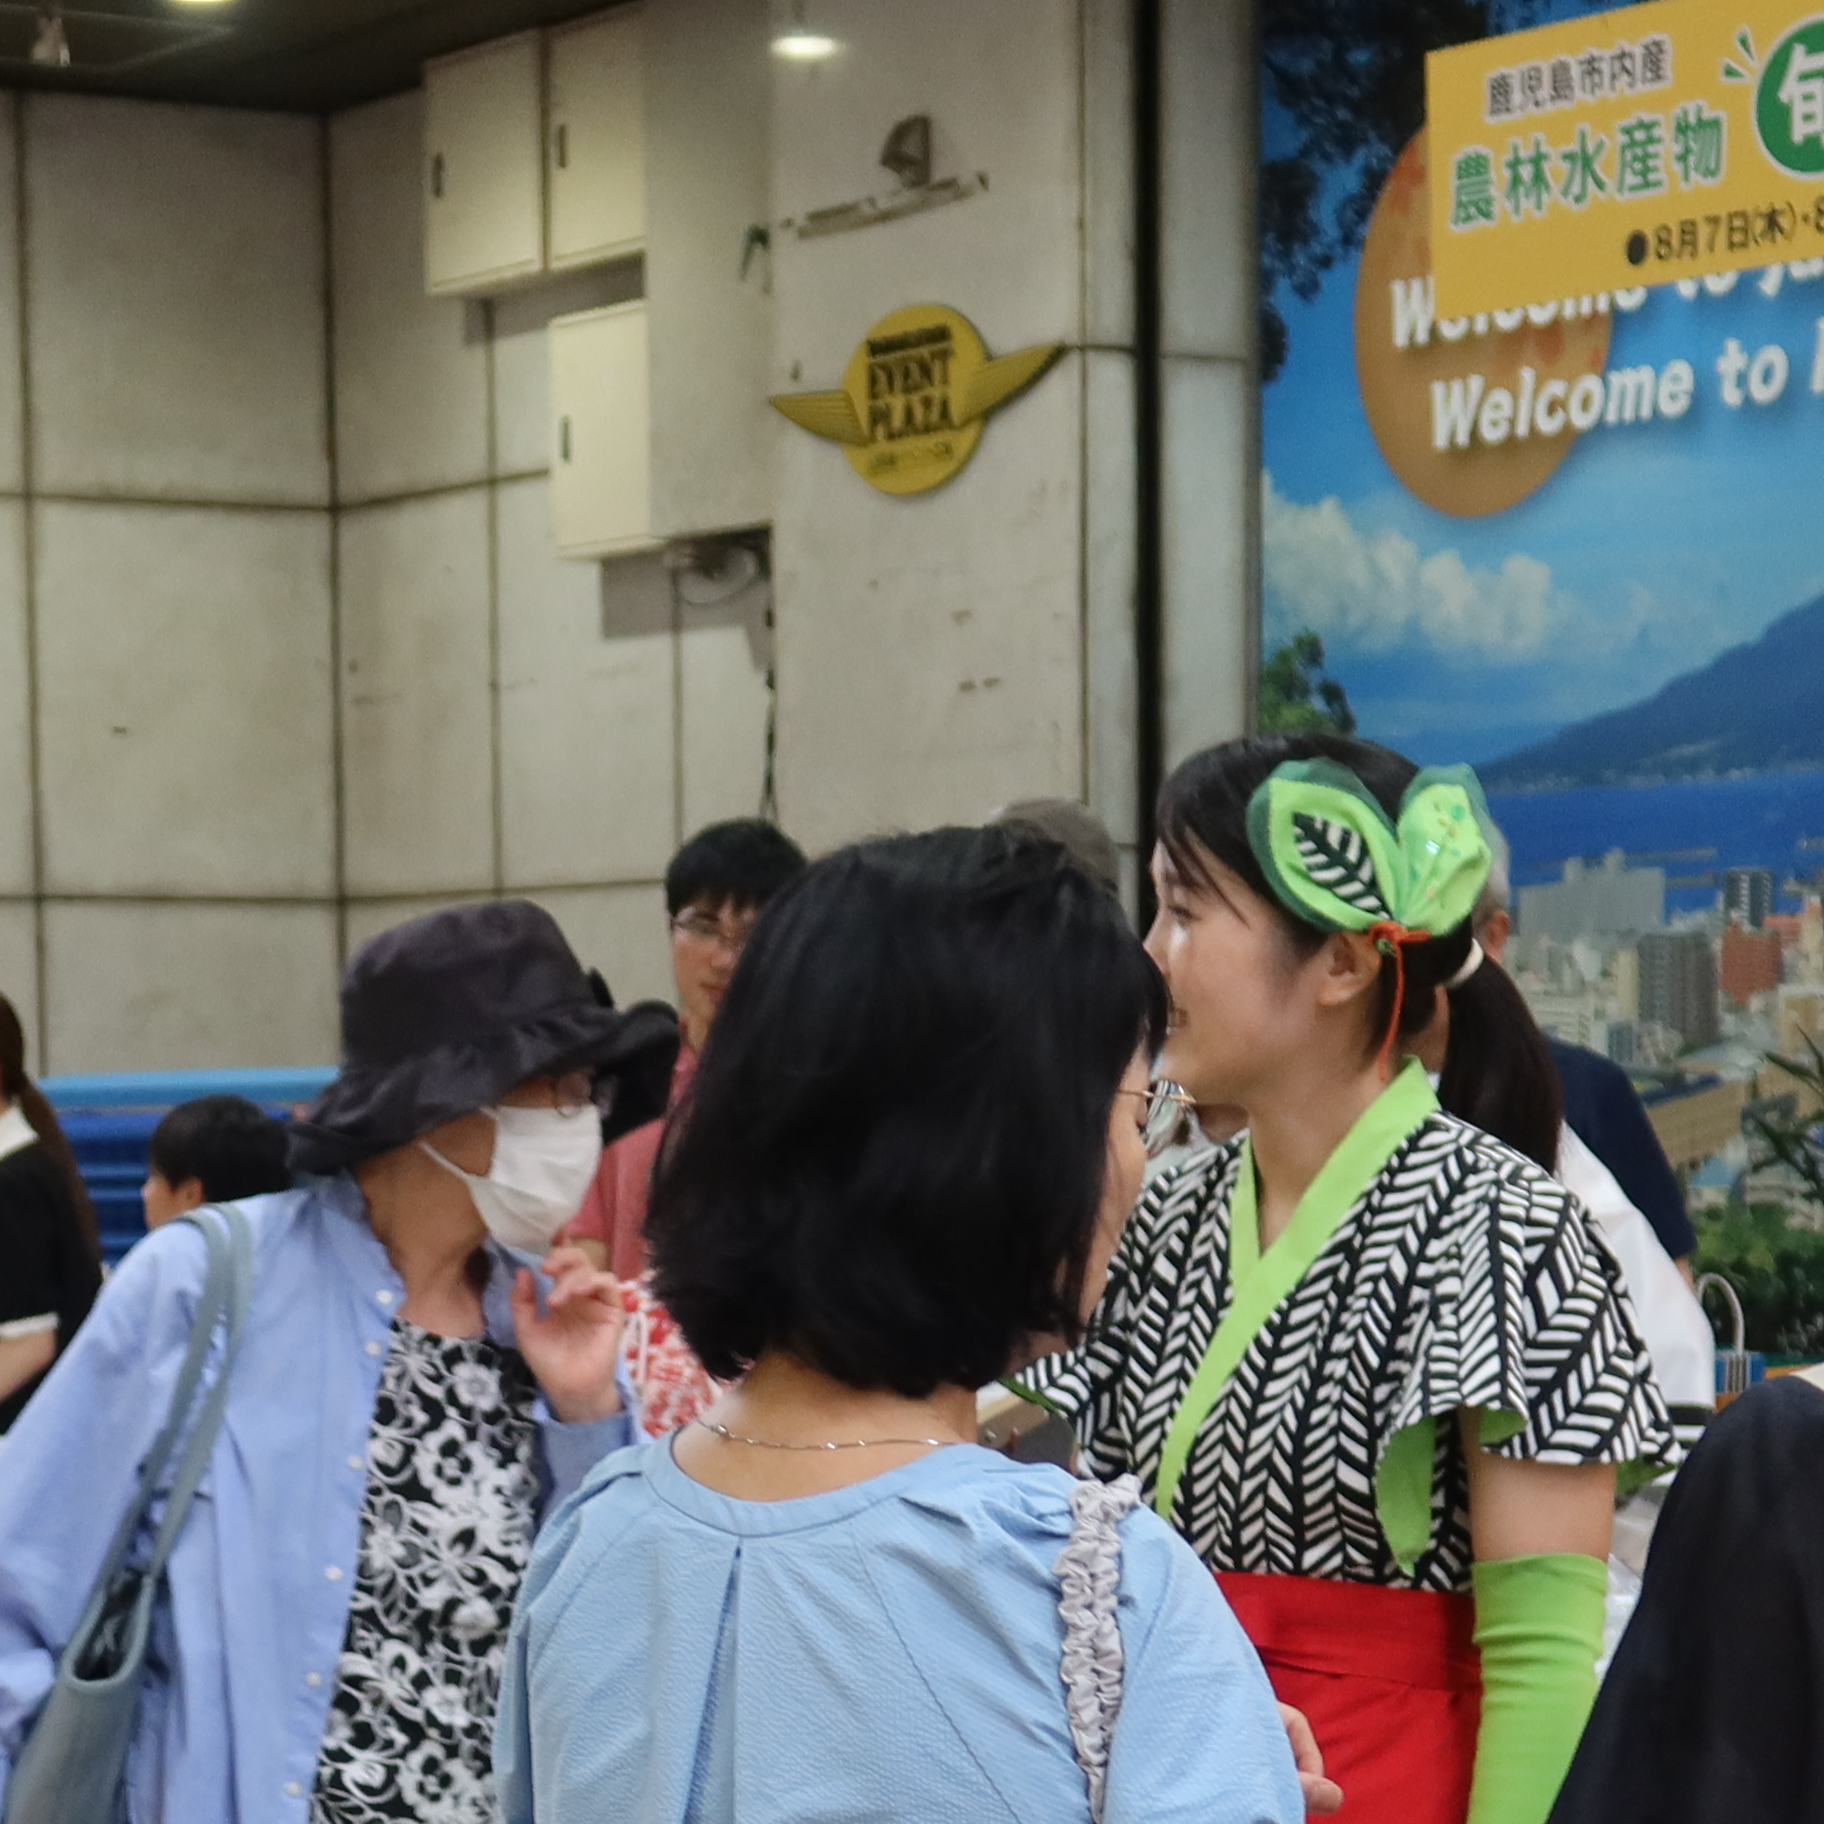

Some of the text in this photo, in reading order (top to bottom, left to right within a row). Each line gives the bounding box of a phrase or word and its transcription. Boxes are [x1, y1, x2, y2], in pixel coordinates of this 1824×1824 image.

[1488, 38, 1669, 118] 鹿児島市内産
[1451, 104, 1724, 228] 農林水産物
[1429, 358, 1693, 452] Welcome
[1717, 338, 1788, 406] to
